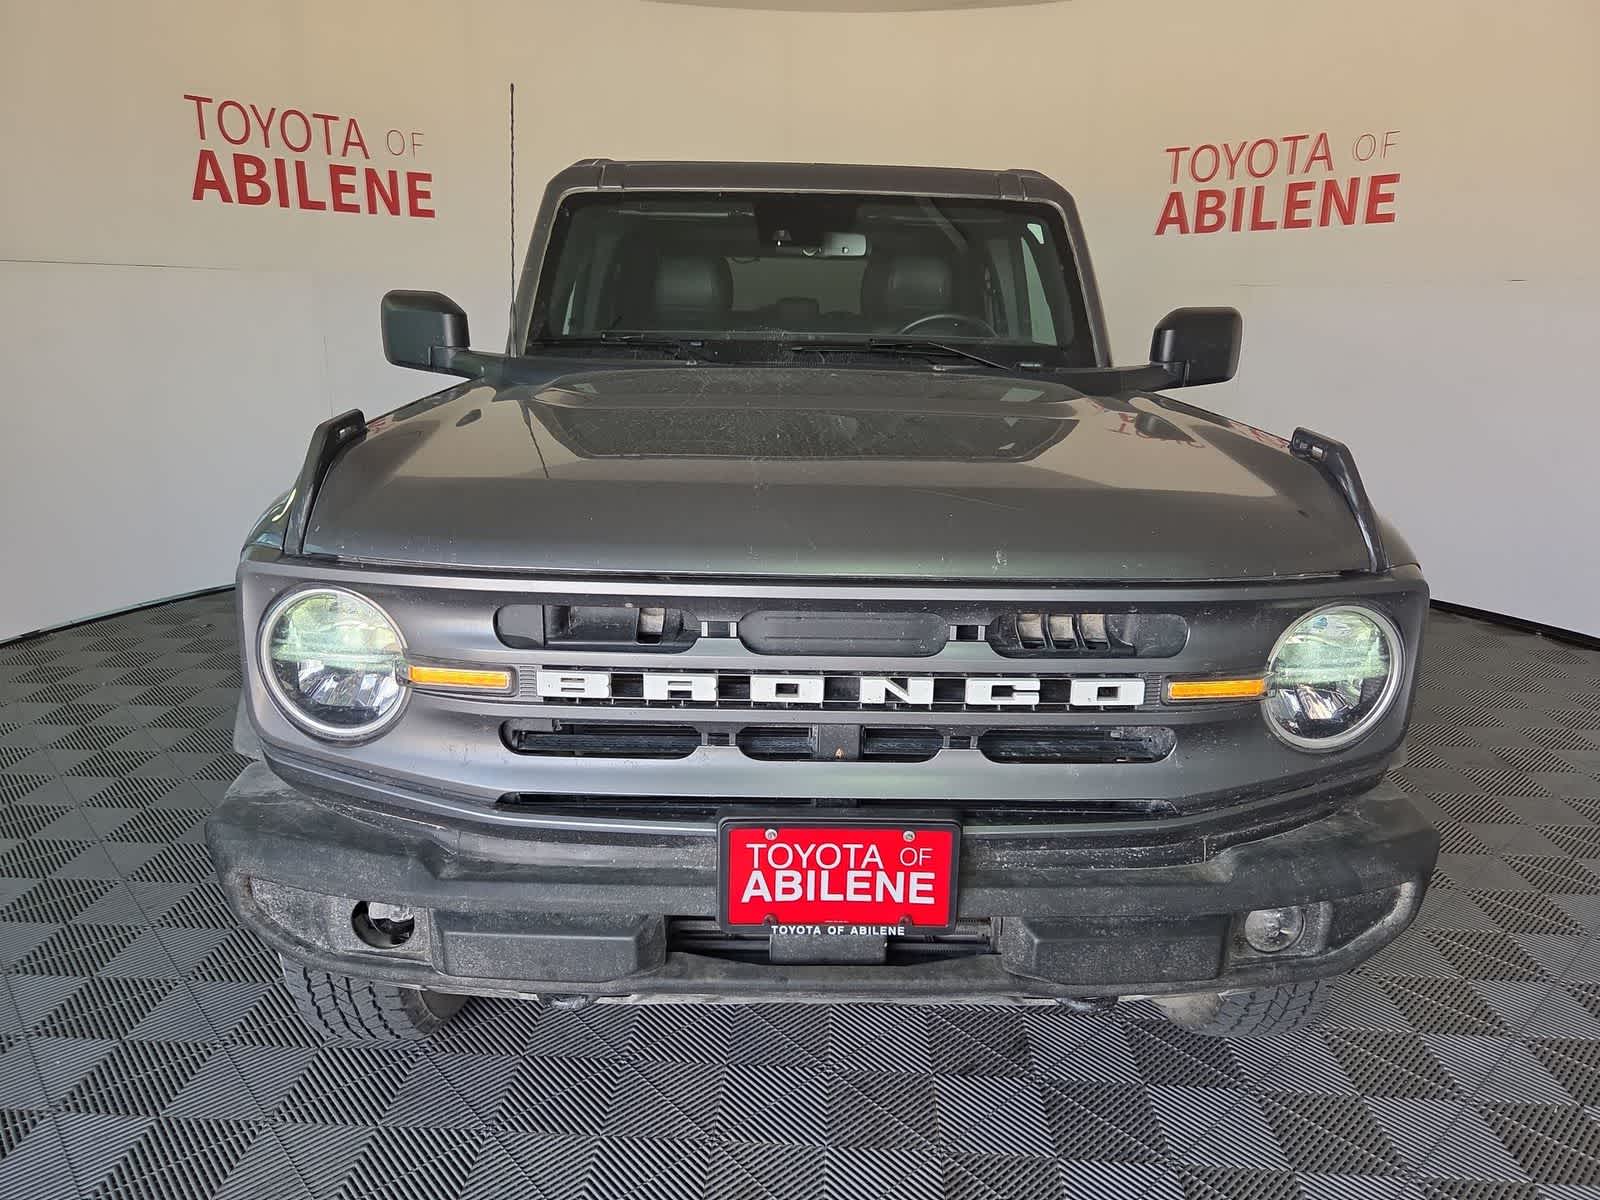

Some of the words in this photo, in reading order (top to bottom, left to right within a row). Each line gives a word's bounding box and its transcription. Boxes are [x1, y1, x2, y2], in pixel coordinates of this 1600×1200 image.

[184, 94, 370, 159] TOYOTA
[386, 129, 424, 157] OF
[1165, 132, 1334, 184] TOYOTA
[1353, 129, 1400, 161] OF
[192, 149, 435, 218] ABILENE
[1155, 173, 1400, 235] ABILENE
[536, 669, 1146, 707] BRONCO
[746, 843, 884, 869] TOYOTA
[900, 848, 933, 866] OF
[741, 870, 935, 904] ABILENE
[771, 925, 821, 935] TOYOTA
[828, 926, 844, 935] OF
[850, 926, 905, 936] ABILENE
